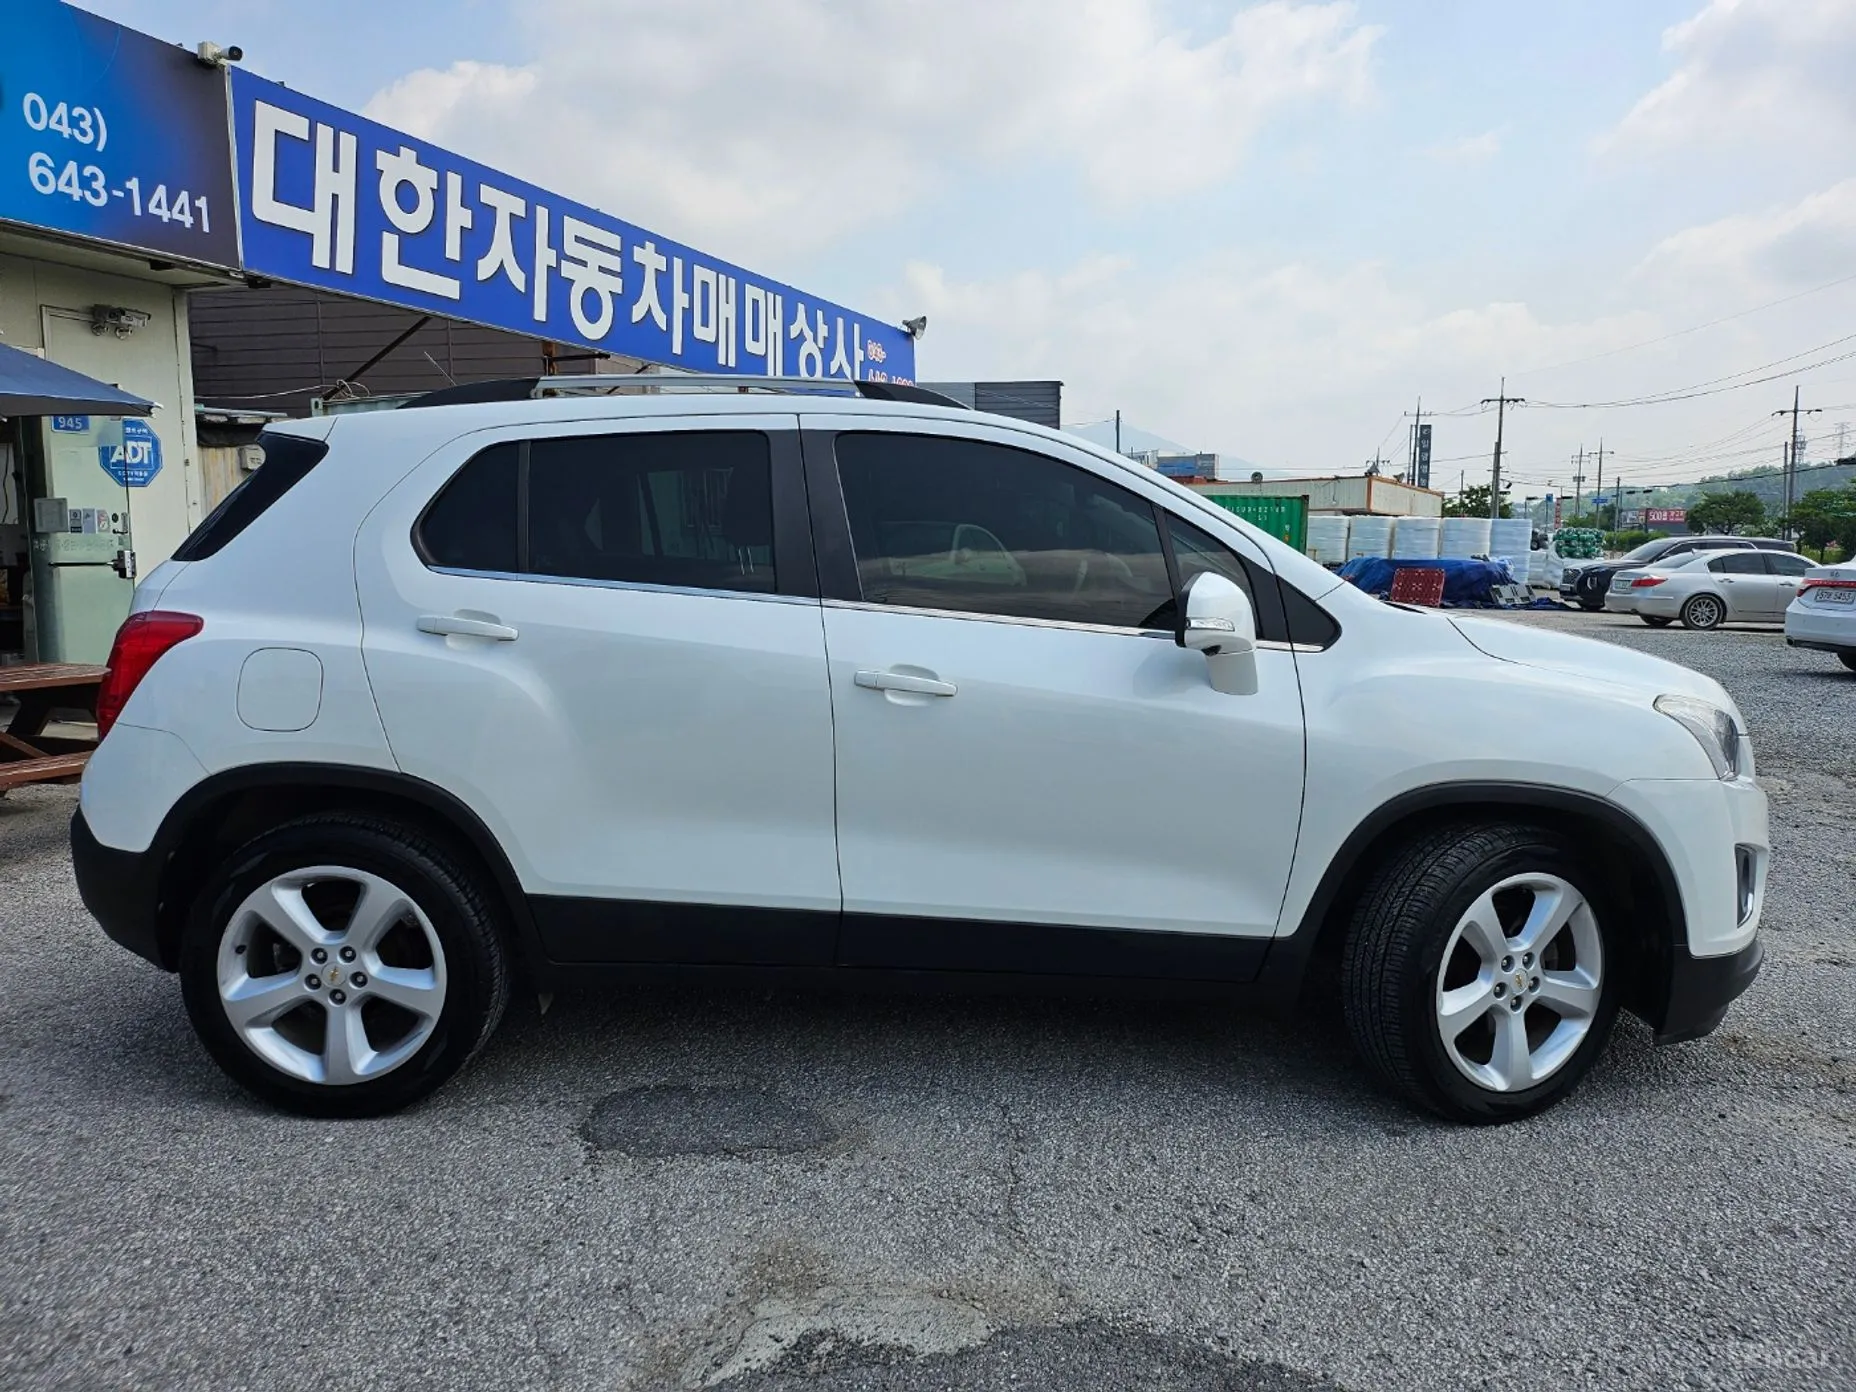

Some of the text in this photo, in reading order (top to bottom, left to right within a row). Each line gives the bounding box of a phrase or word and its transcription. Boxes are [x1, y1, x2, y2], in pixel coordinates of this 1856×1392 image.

[22, 92, 108, 152] 043)
[28, 152, 210, 233] 643-1441
[252, 100, 865, 380] 대한자동차매매상사
[58, 417, 82, 430] 945
[110, 440, 152, 464] ADT
